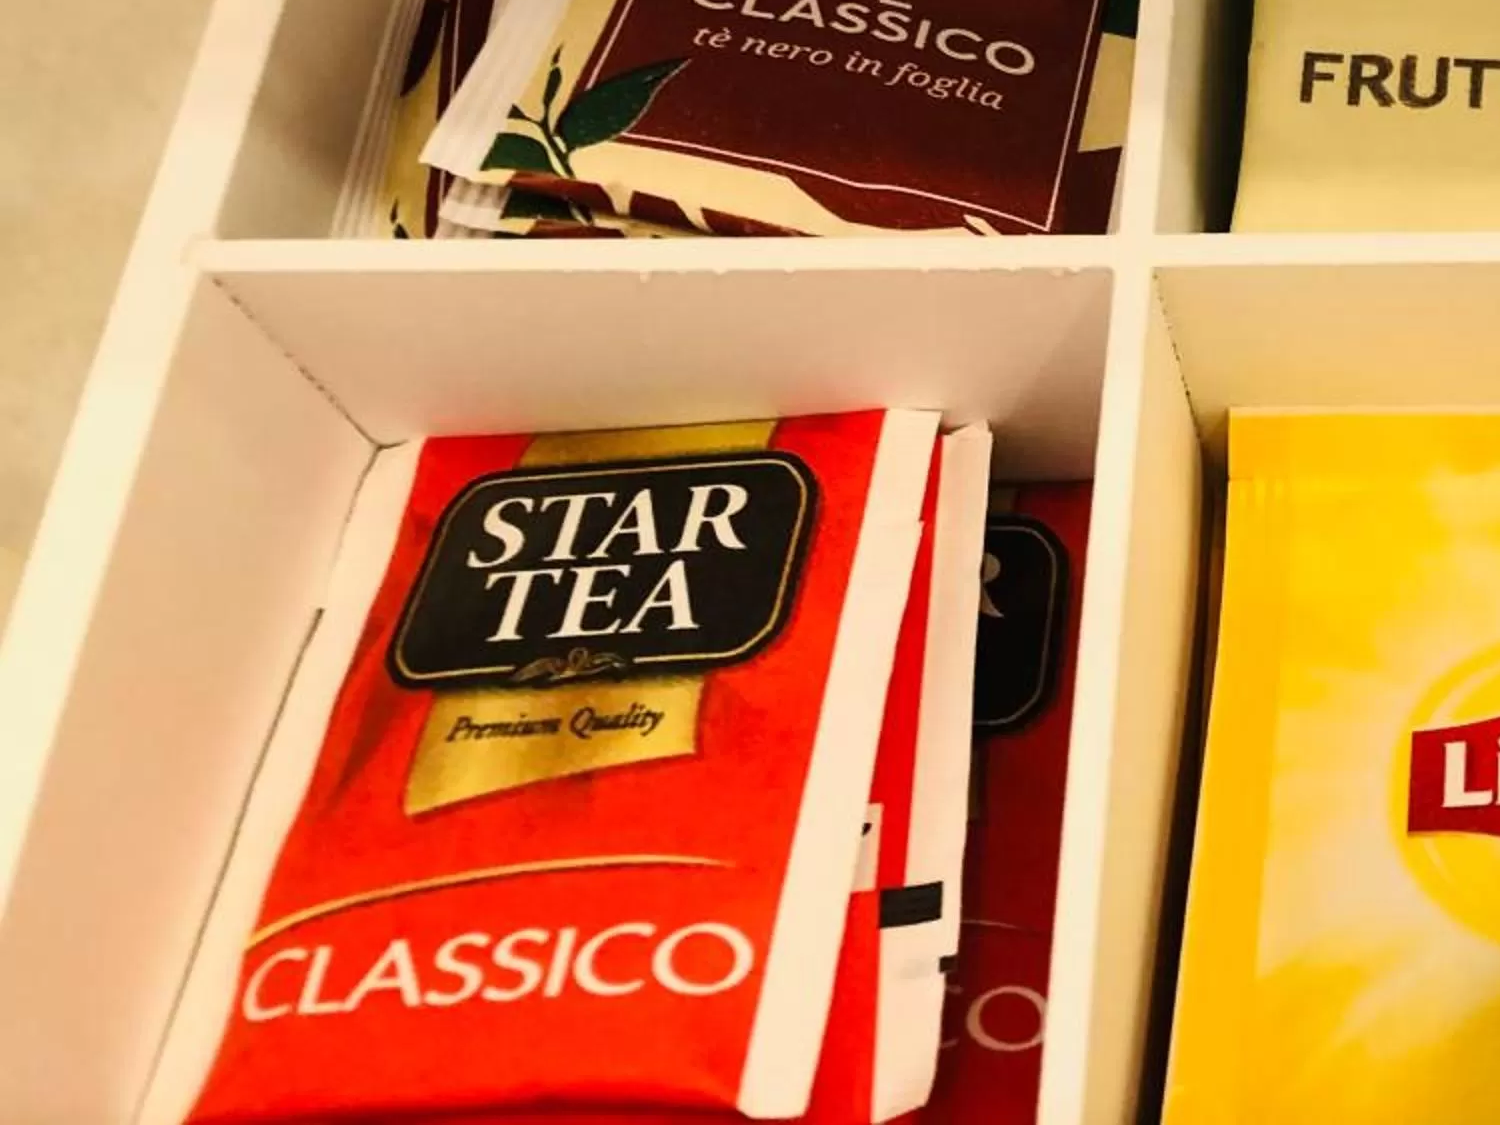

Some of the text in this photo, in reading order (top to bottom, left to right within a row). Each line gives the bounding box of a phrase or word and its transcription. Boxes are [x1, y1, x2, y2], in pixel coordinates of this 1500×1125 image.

[692, 27, 1005, 111] tè nero in foglia
[466, 483, 749, 569] STAR
[484, 561, 699, 643] TEA
[445, 705, 666, 744] Premium Quality
[242, 922, 755, 1022] CLASSICO
